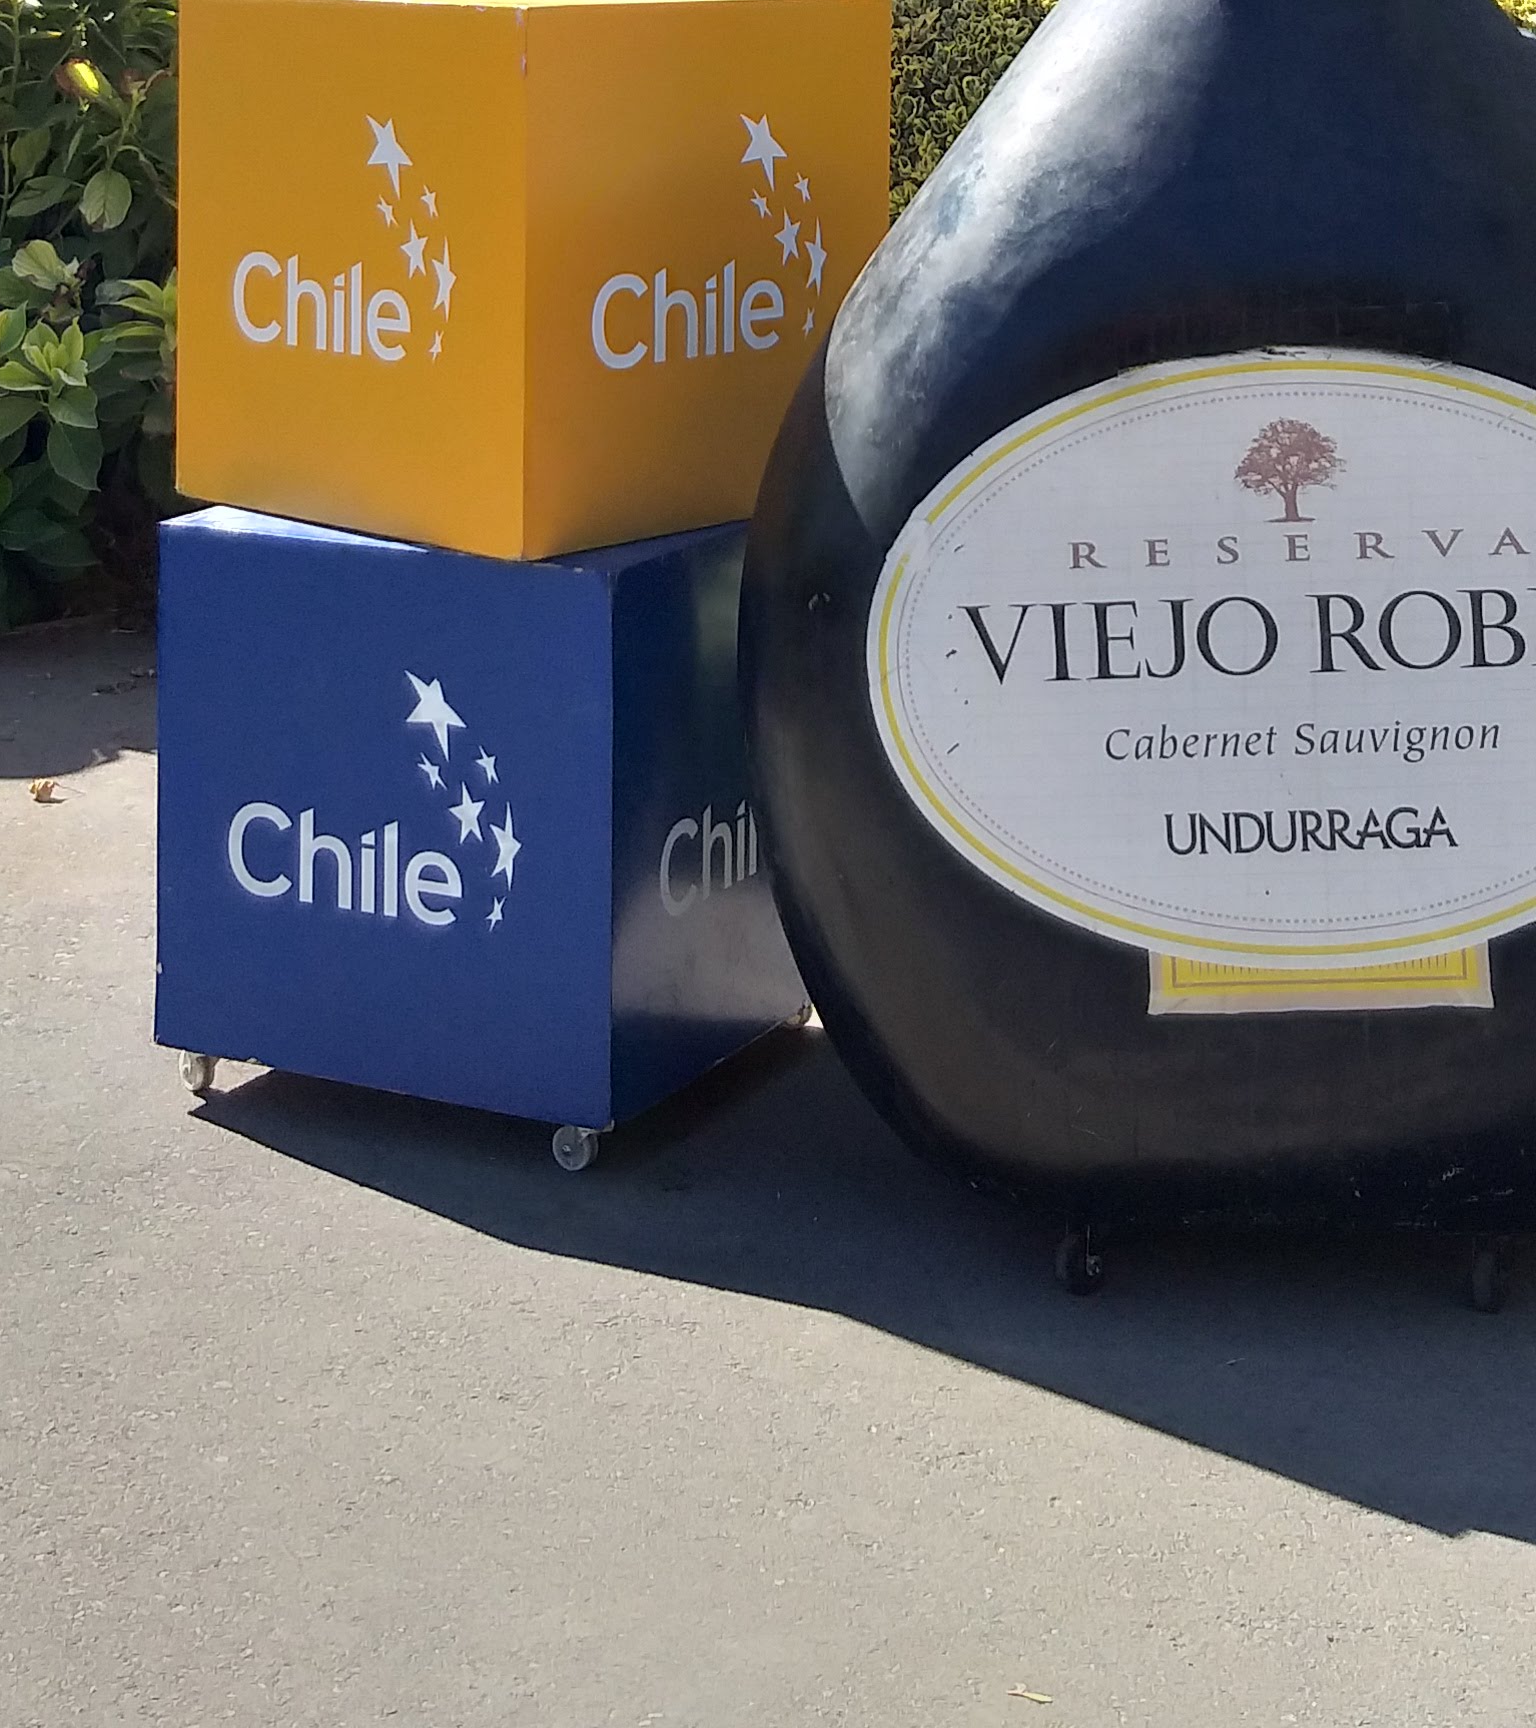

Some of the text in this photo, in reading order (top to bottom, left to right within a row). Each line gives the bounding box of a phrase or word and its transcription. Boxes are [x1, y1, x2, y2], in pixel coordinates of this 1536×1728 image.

[233, 251, 411, 361] Chile
[592, 259, 784, 369] Chile
[1069, 527, 1530, 569] RESERVA
[957, 596, 1278, 685] VIEJO
[1105, 720, 1500, 762] Cabernet Sauvignon
[228, 801, 462, 926] Chile
[660, 799, 757, 917] Chil
[1165, 806, 1458, 855] UNDURRAGA
